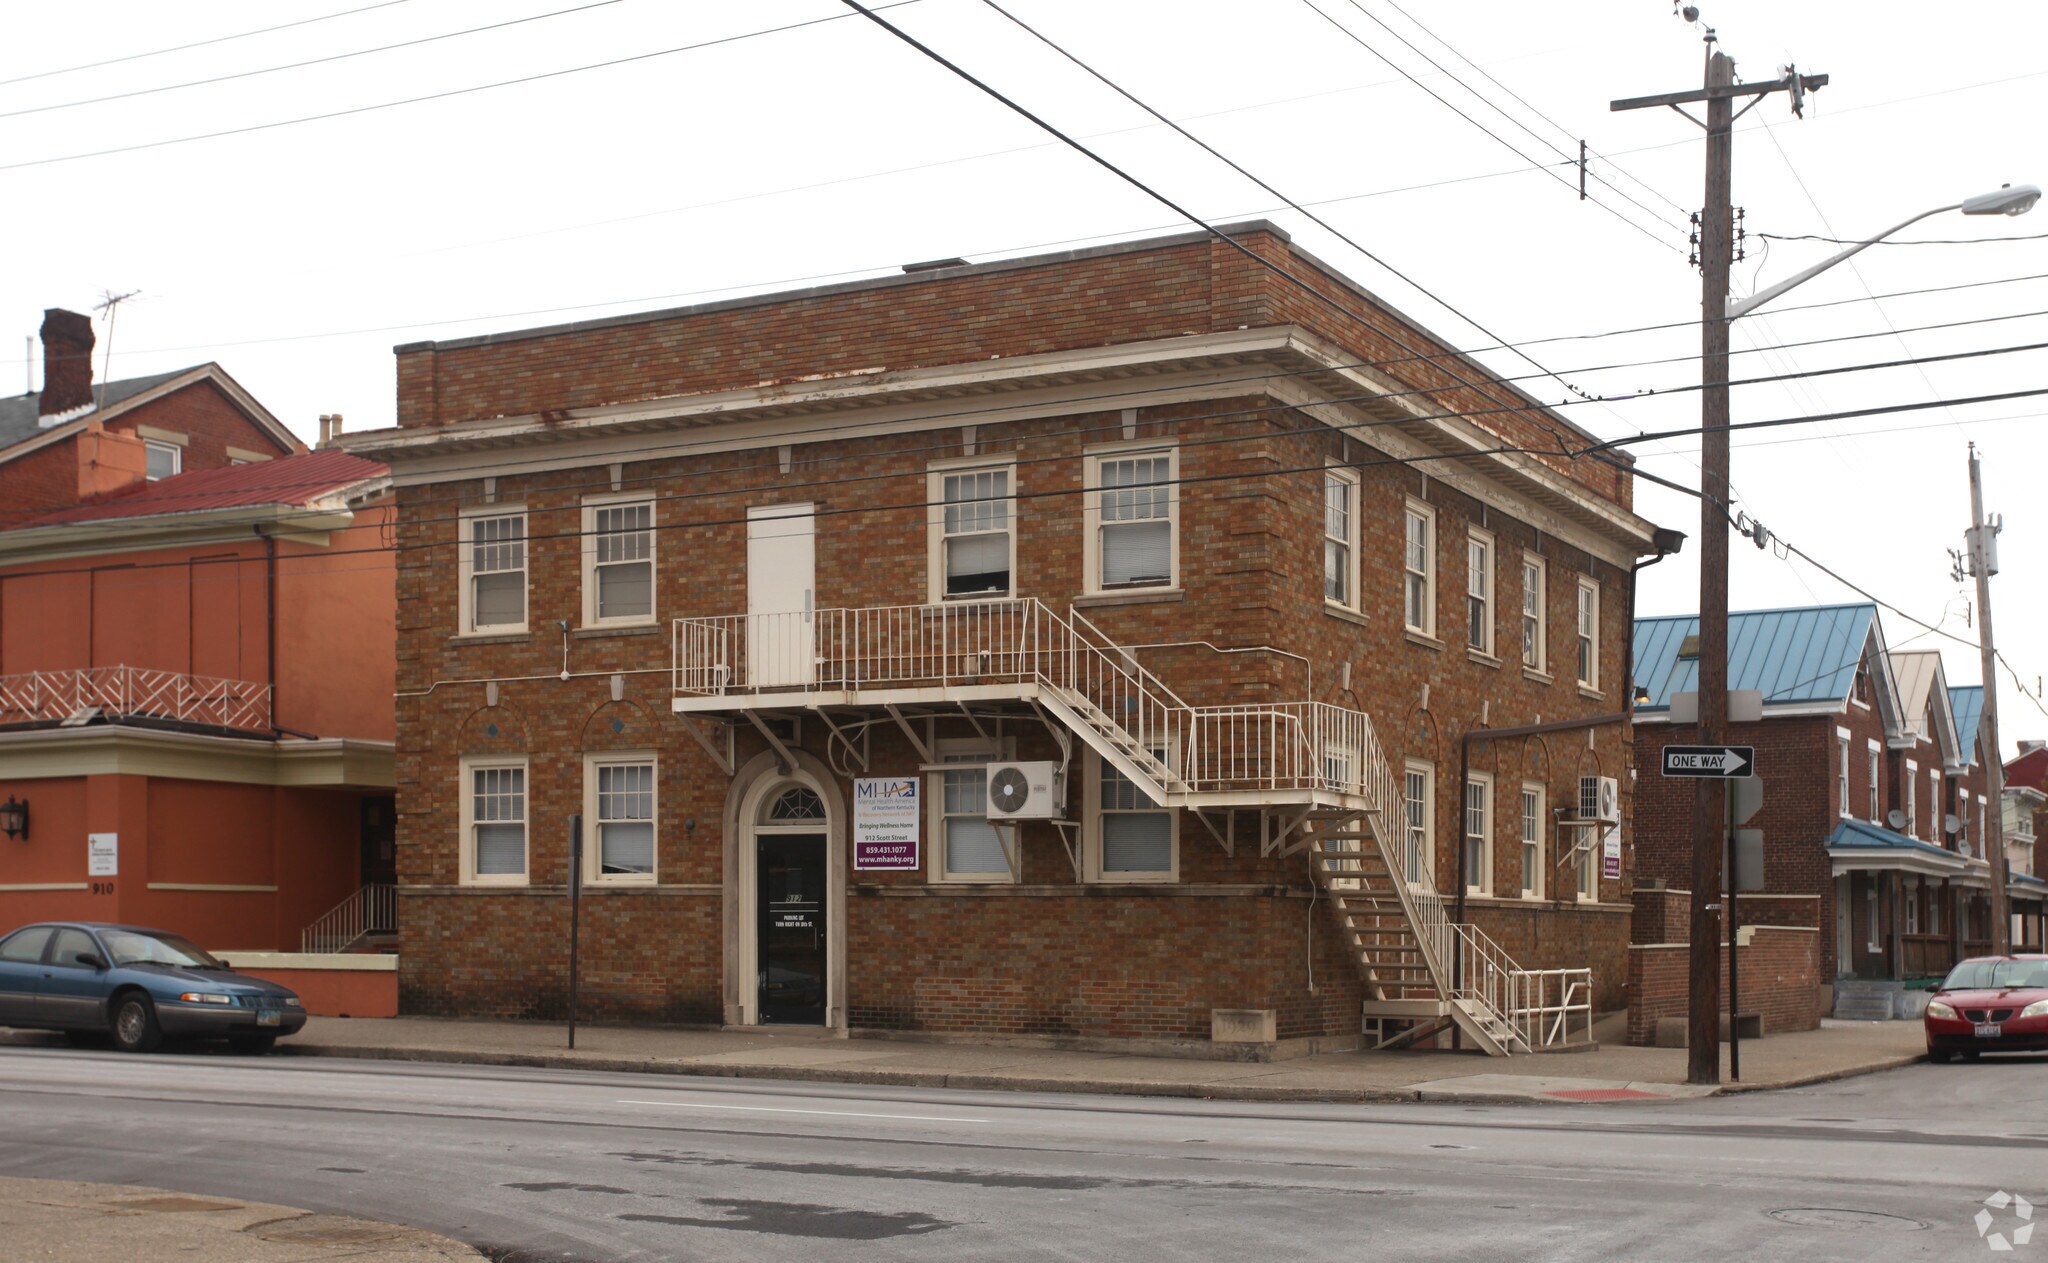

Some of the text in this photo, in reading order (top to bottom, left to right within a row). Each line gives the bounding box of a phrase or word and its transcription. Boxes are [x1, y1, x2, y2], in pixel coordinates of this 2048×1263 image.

[1672, 755, 1725, 768] ONE WAY
[858, 782, 901, 798] MHA
[865, 846, 907, 854] 859.431.1077
[858, 855, 914, 864] www.mhanky.org
[92, 882, 114, 895] 910
[785, 894, 803, 902] 912
